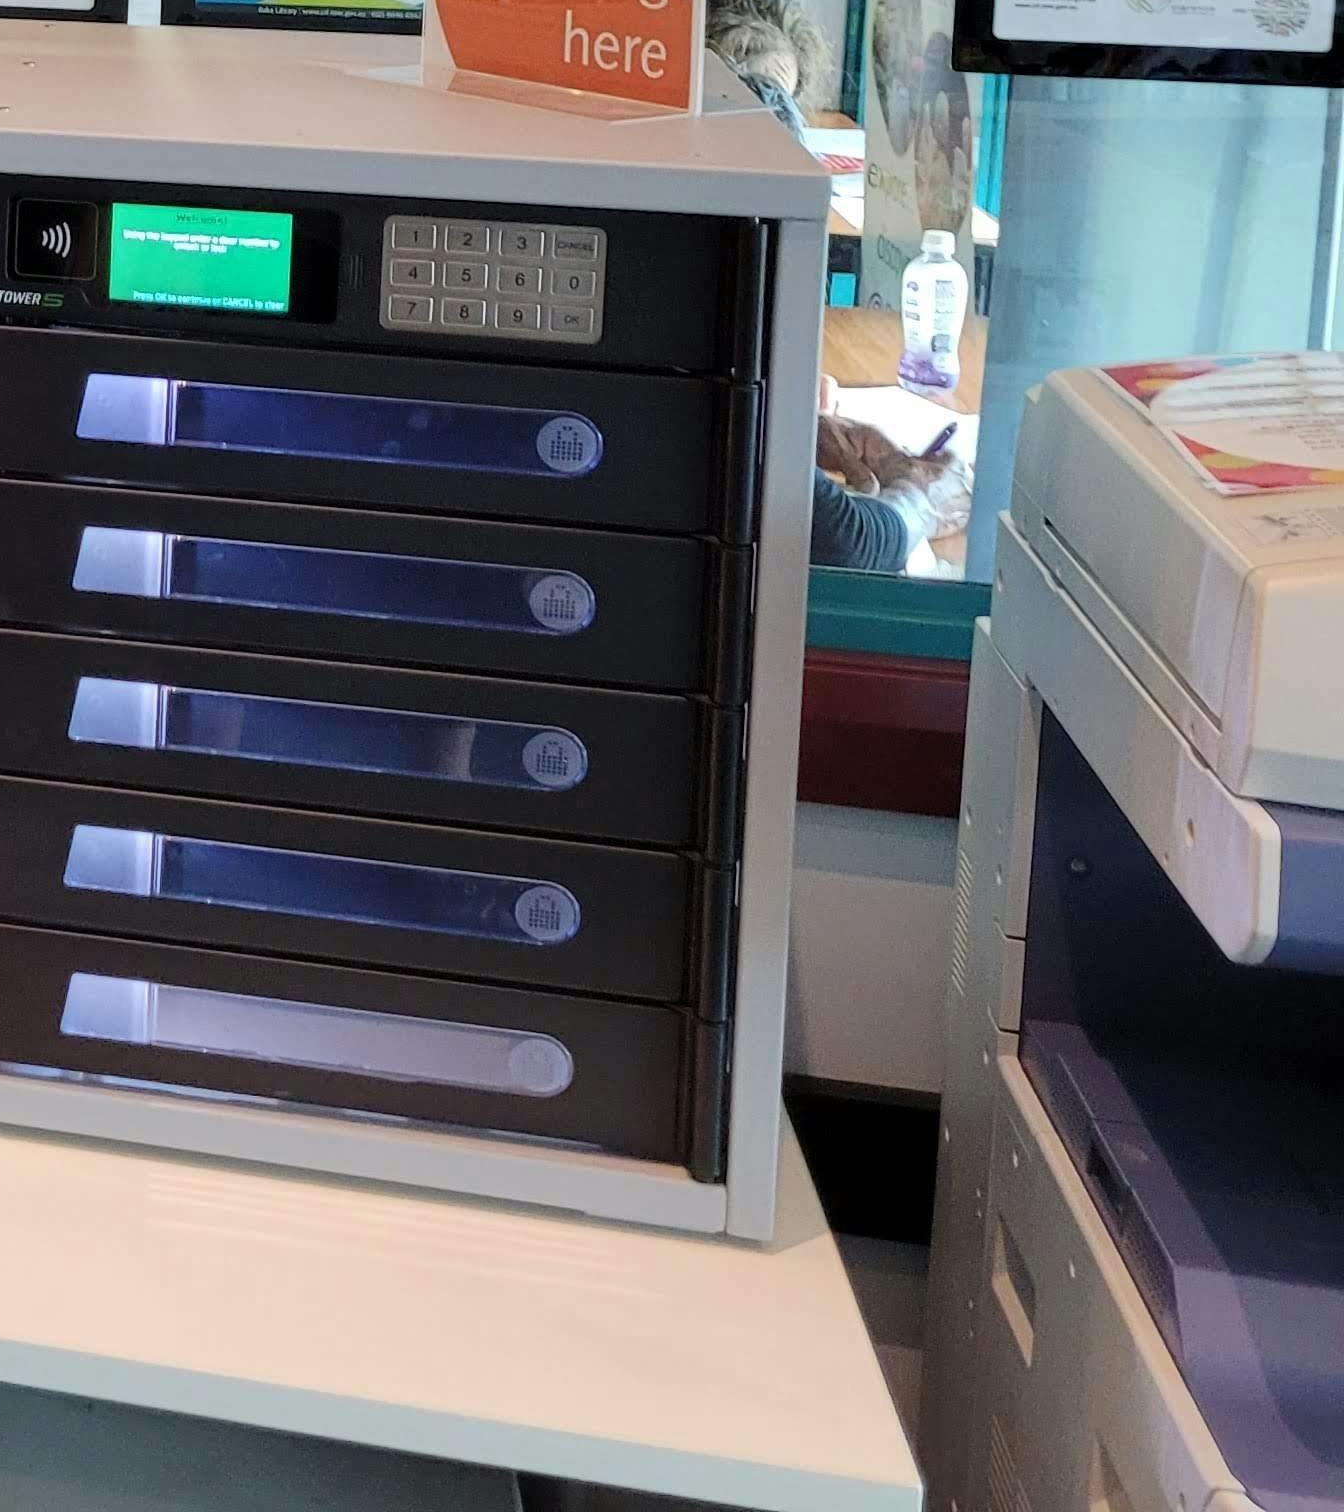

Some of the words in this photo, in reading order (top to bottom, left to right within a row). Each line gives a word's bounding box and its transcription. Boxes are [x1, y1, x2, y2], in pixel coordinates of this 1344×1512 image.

[563, 8, 666, 79] here
[463, 233, 473, 246] 2
[517, 237, 527, 250] 3
[408, 267, 418, 279] 4
[462, 268, 472, 282] 5
[515, 273, 525, 287] 6
[407, 302, 417, 315] 7
[459, 305, 469, 319] 8
[513, 310, 523, 324] 9
